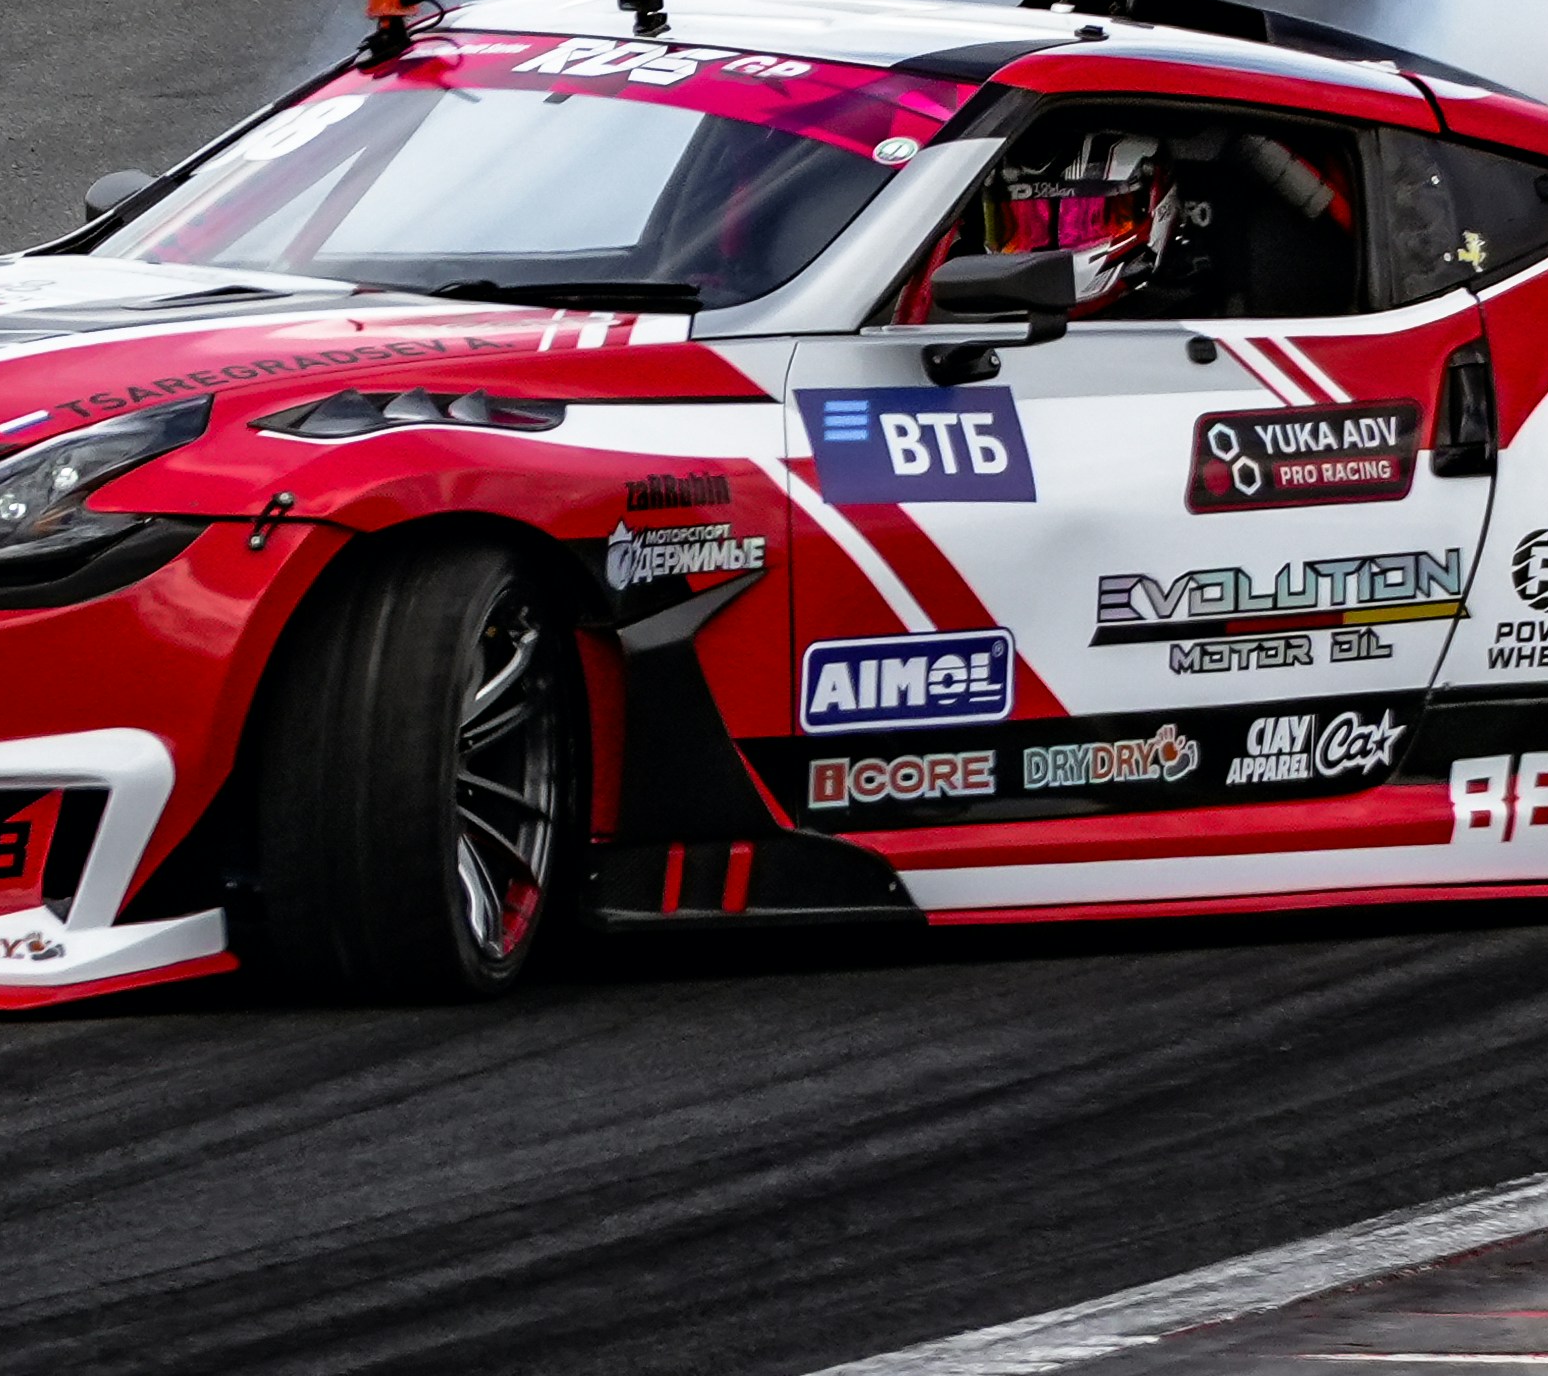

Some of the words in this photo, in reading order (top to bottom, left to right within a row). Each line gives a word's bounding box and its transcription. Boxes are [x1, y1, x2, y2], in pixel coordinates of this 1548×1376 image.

[511, 37, 741, 85] RDS
[721, 55, 812, 80] GP
[55, 338, 446, 420] TSAREGRADSEV
[464, 335, 513, 353] A.
[879, 413, 1008, 475] ВТБ
[1255, 422, 1339, 455] YUKA
[1343, 417, 1397, 449] ADV
[1280, 464, 1317, 485] PRO
[1323, 460, 1392, 483] RACING
[646, 524, 732, 545] МОТОРСПОРТ
[1097, 548, 1462, 623] EVOLUTION
[1170, 634, 1313, 675] MOTOR
[1330, 628, 1393, 663] OIL
[809, 651, 1003, 714] AIMOL
[1024, 740, 1156, 788] DRYDRY
[1225, 753, 1309, 785] APPAREL
